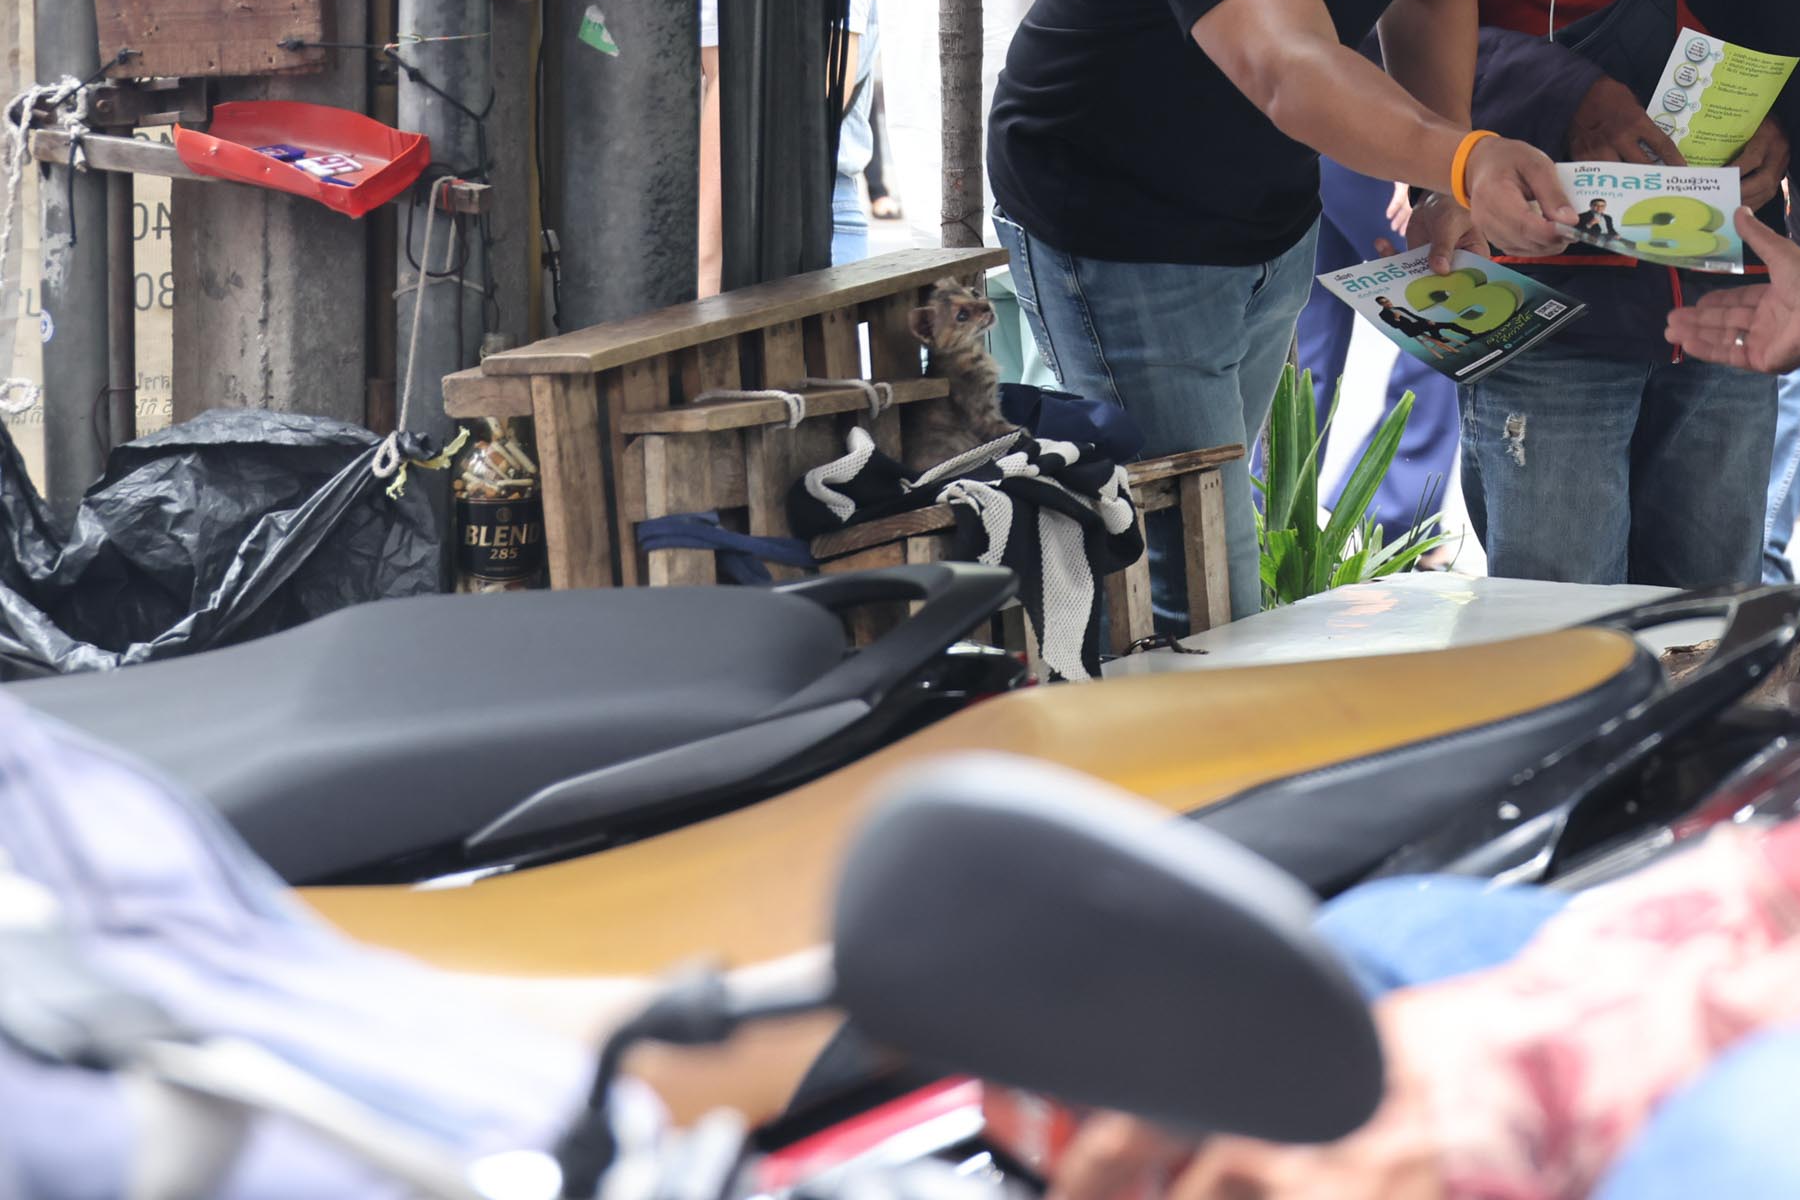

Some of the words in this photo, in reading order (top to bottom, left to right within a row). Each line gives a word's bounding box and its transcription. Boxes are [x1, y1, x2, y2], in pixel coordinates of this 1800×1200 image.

[1574, 173, 1662, 191] สกลธี
[1621, 195, 1731, 257] 3
[1342, 263, 1409, 294] สกลธี
[1405, 267, 1525, 336] 3
[465, 523, 538, 547] BLEND
[489, 547, 519, 560] 285
